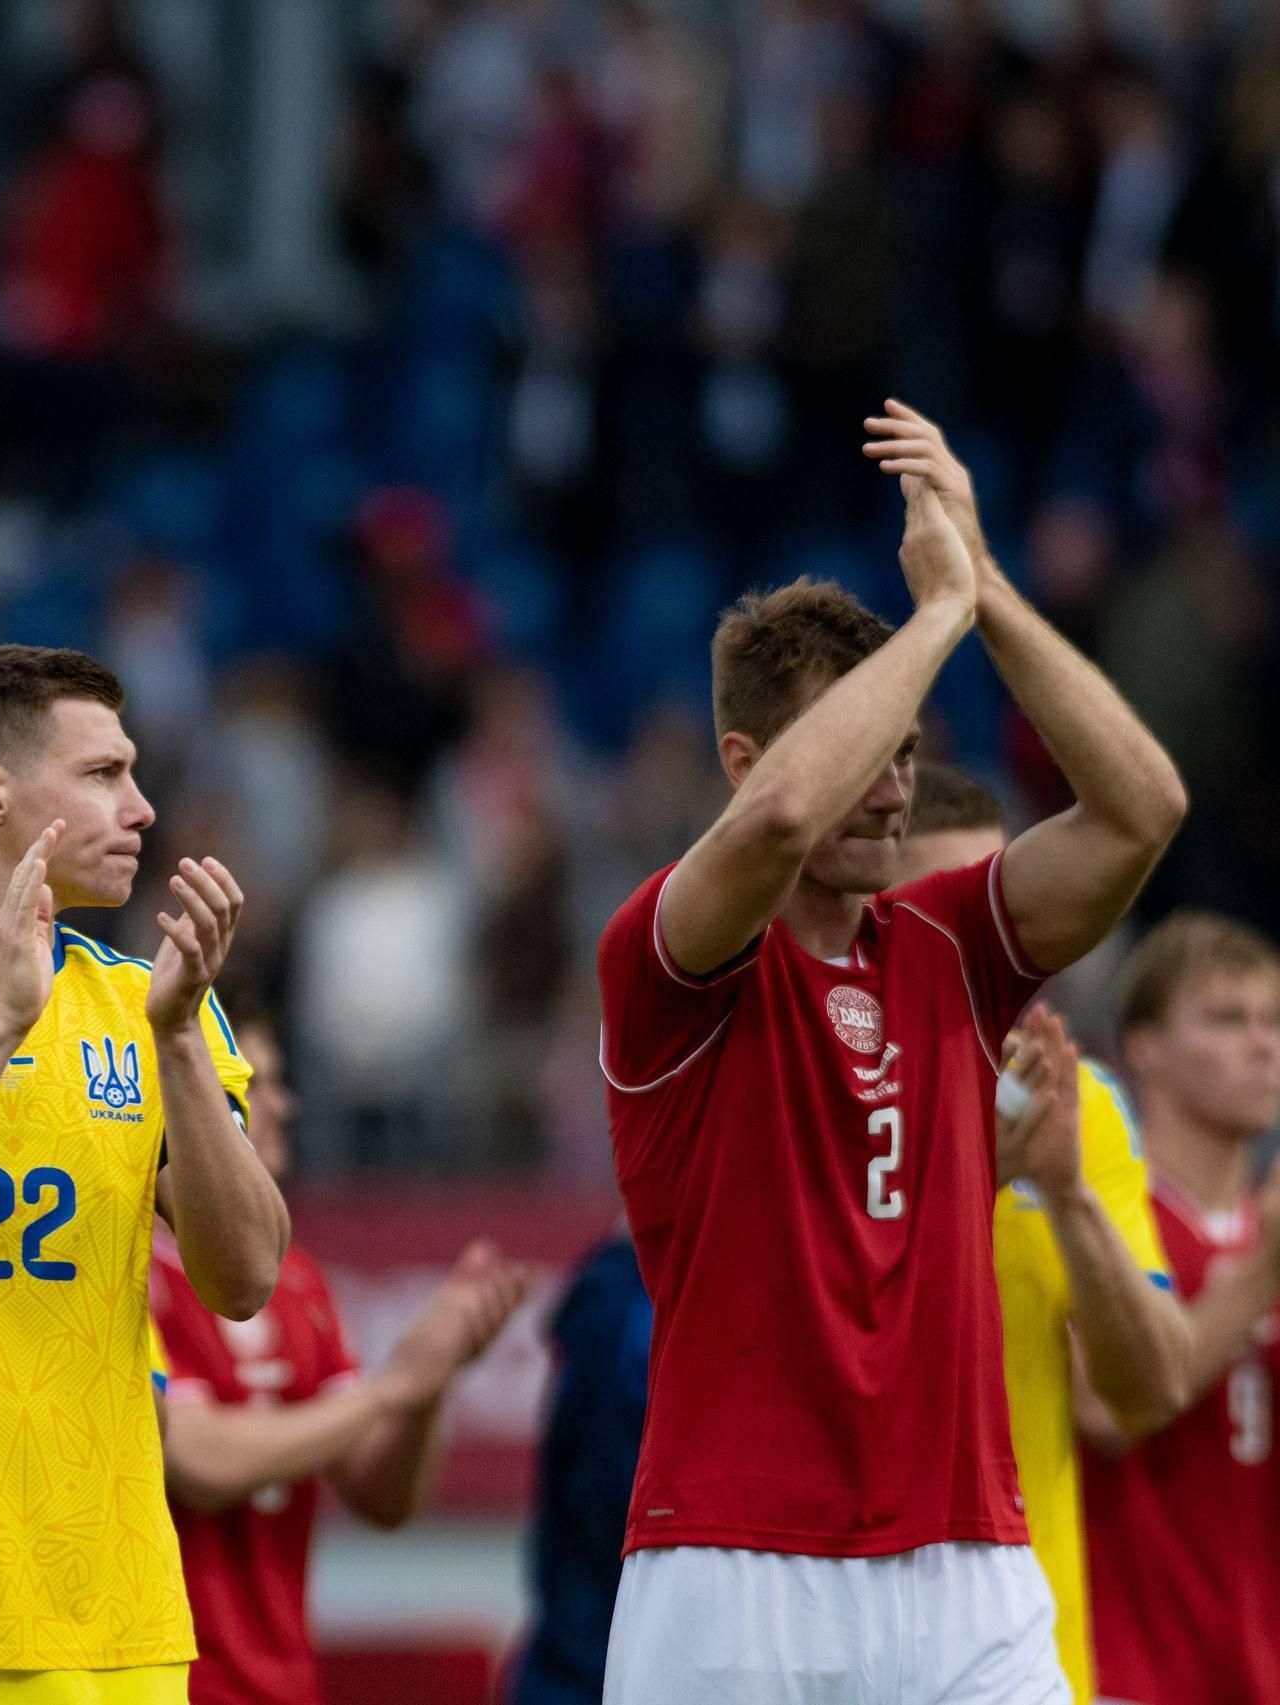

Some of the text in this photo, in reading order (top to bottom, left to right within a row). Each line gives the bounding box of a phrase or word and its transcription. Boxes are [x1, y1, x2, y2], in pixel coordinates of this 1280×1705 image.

[838, 1006, 876, 1030] DBU
[851, 1039, 875, 1050] 1889
[89, 1109, 145, 1123] UKRAINE
[866, 1107, 902, 1219] 2
